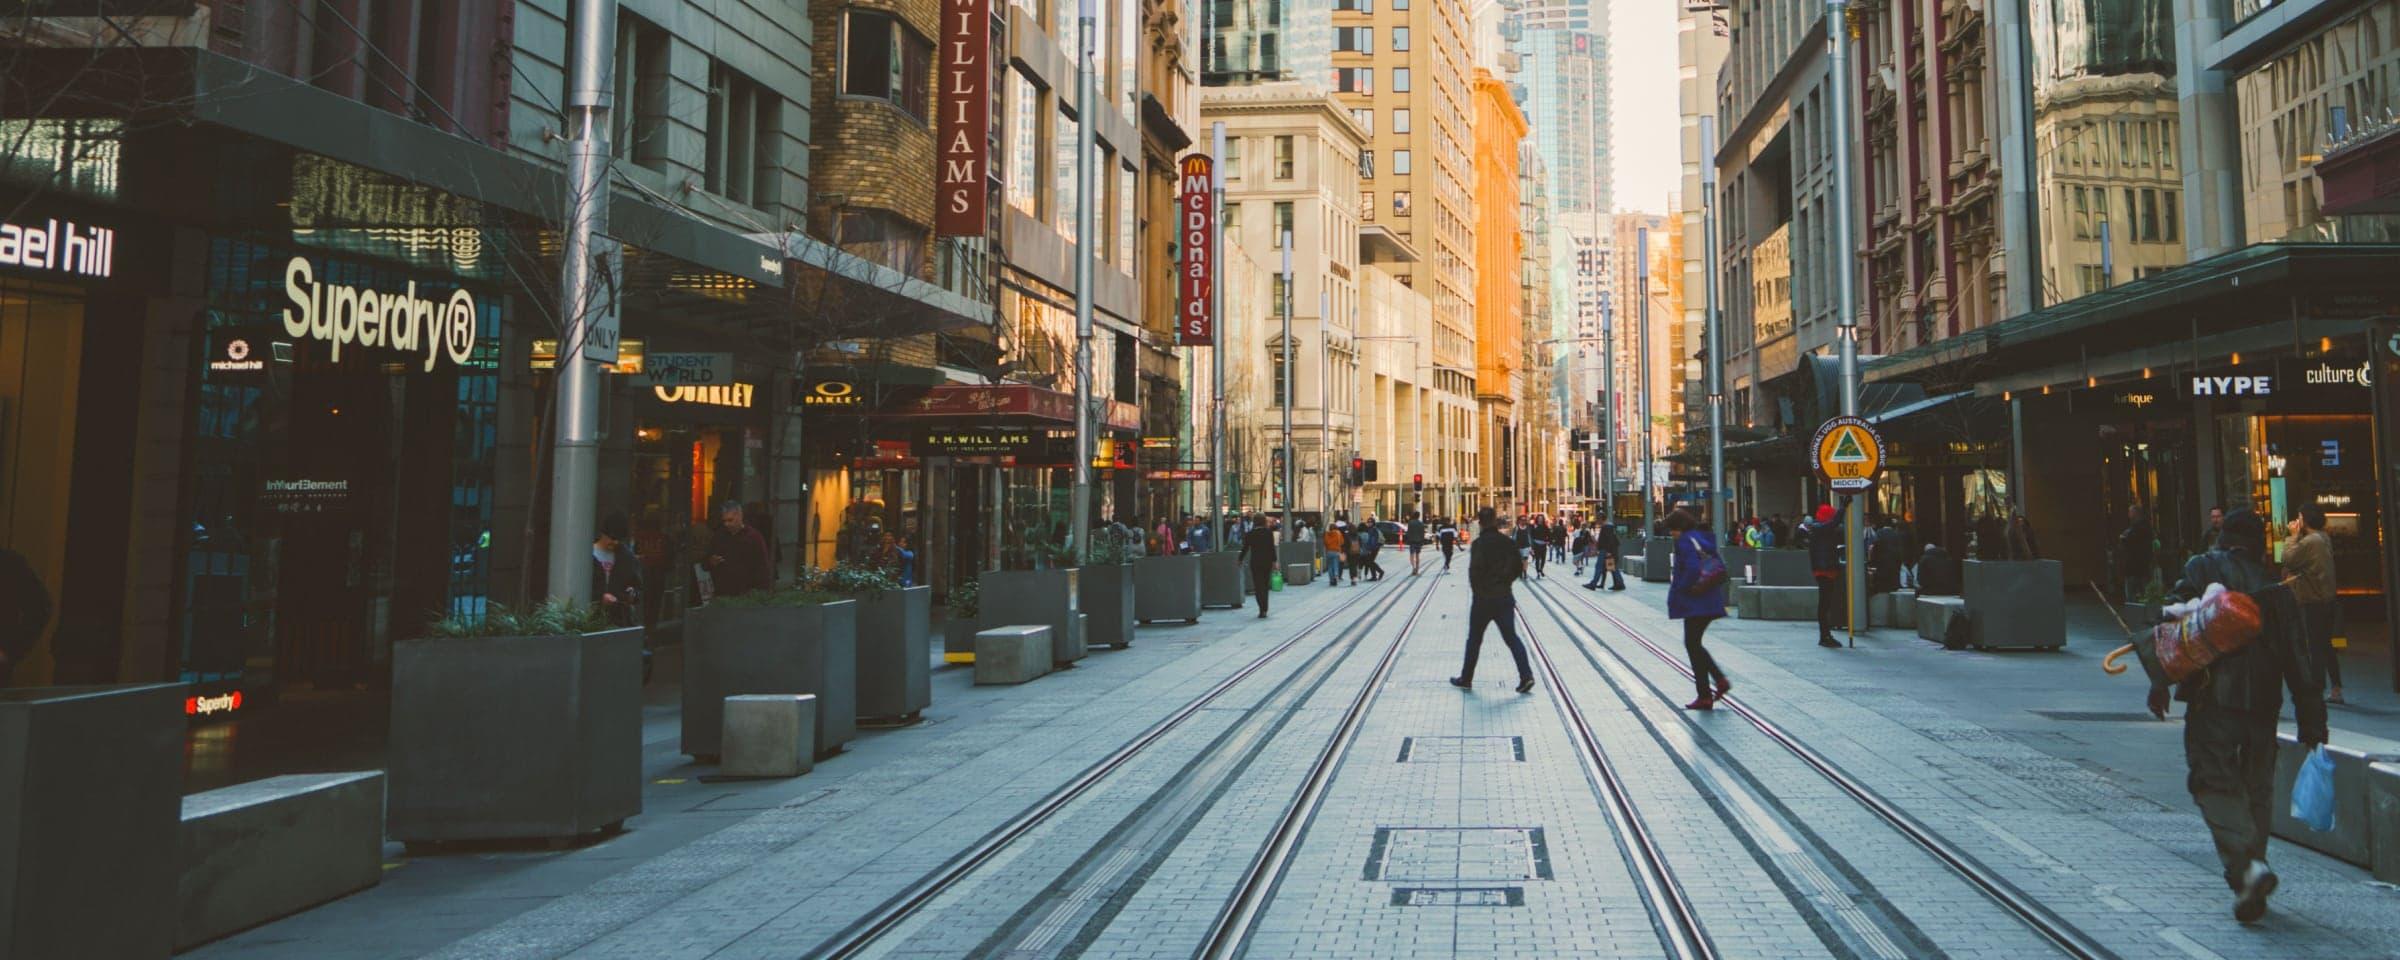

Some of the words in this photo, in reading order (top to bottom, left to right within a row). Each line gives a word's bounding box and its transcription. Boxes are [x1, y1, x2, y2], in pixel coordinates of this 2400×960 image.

[945, 0, 976, 213] ILLIAMS
[64, 221, 113, 278] hill
[1185, 175, 1209, 335] McDonald's
[587, 327, 617, 351] ONLY
[647, 355, 714, 368] STUDENT
[2306, 363, 2355, 384] culture
[2193, 376, 2271, 395] HYPE
[928, 435, 1029, 444] R.M.WILLAMS
[1822, 420, 1838, 434] UGG
[1838, 418, 1876, 436] AUSTRALIA
[1874, 434, 1886, 467] CLASSIC
[1839, 463, 1859, 477] UGG
